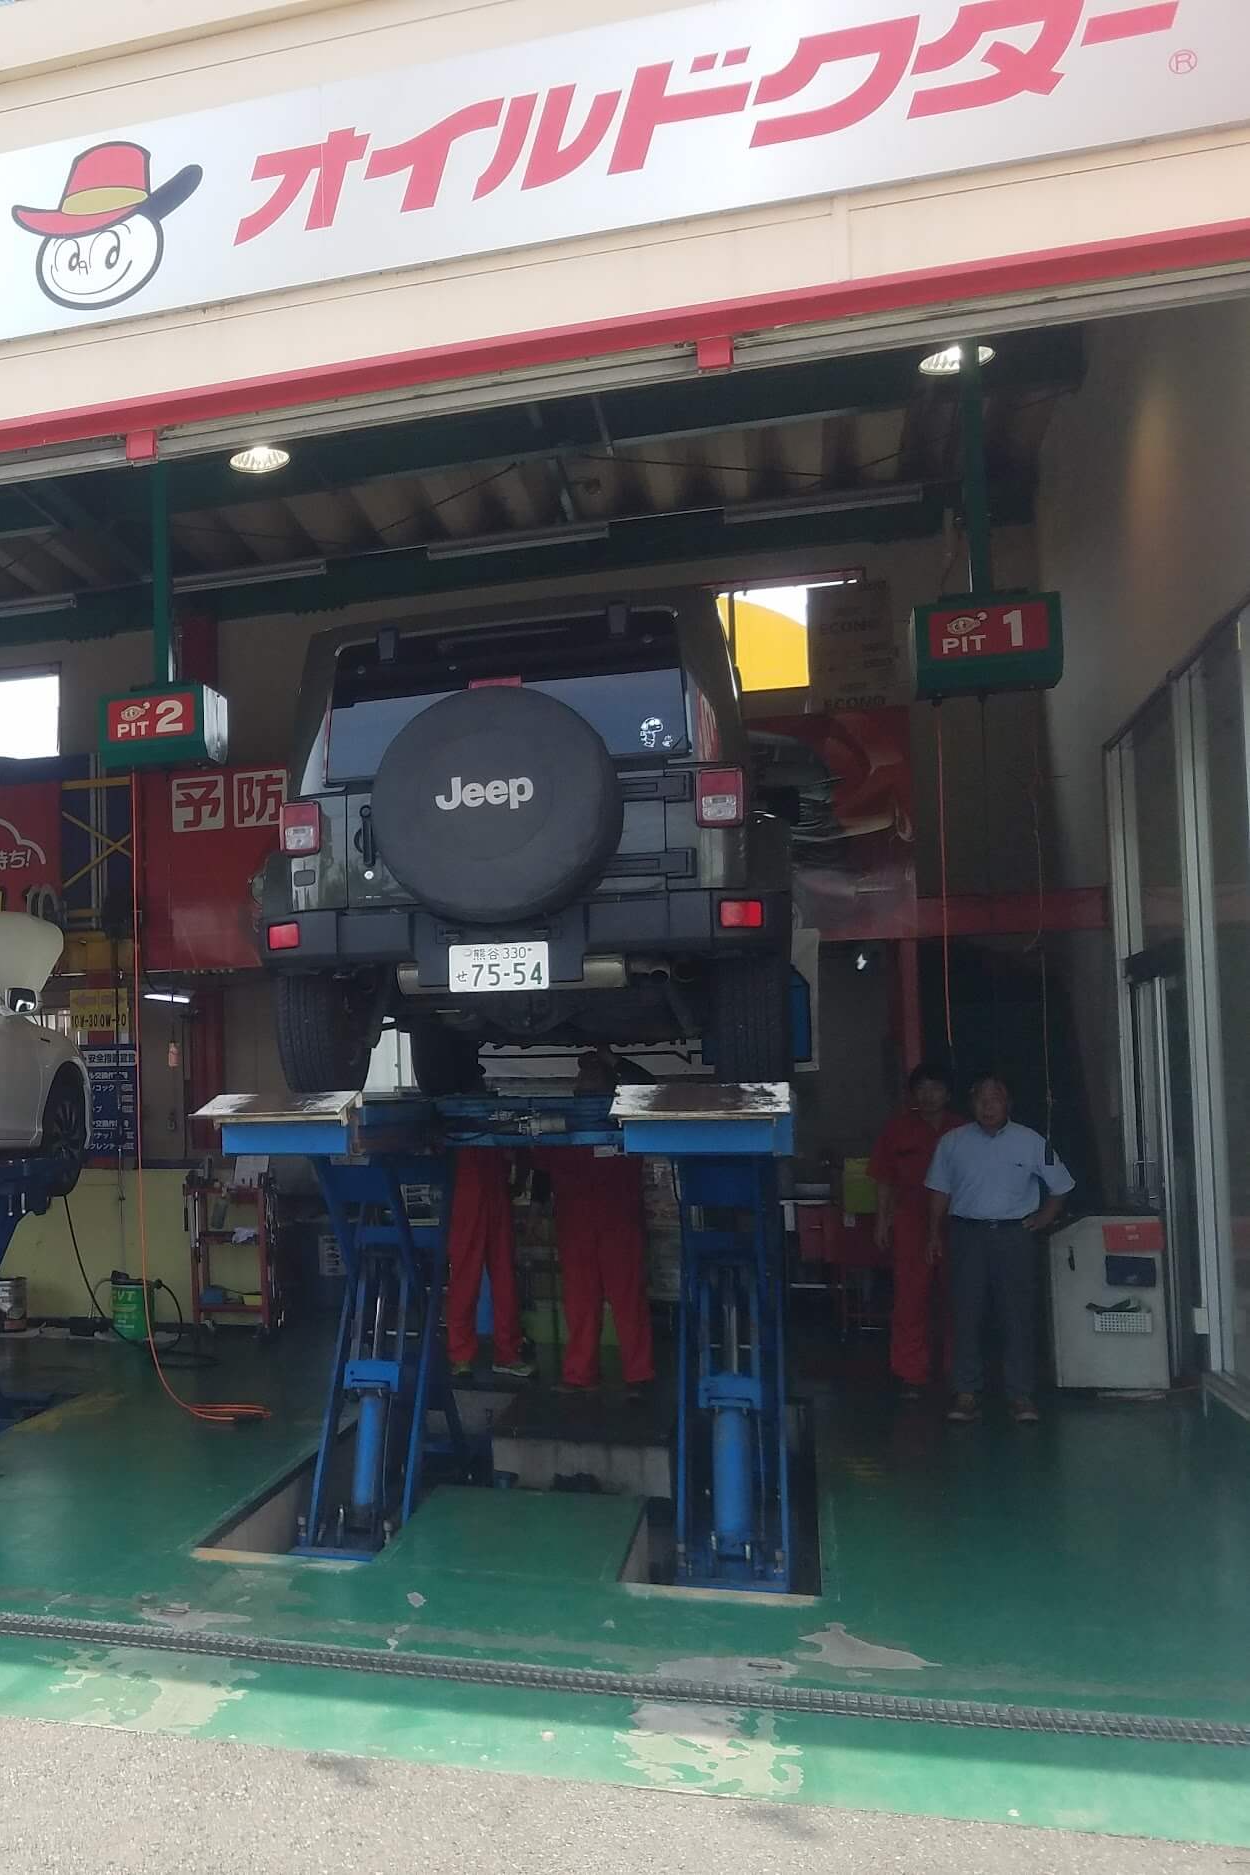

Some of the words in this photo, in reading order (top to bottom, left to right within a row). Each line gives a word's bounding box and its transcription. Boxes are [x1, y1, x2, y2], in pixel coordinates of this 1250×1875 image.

[234, 0, 1179, 246] オイルドクター
[942, 634, 987, 654] PIT
[1002, 609, 1023, 647] 1
[117, 721, 149, 738] PIT
[155, 699, 183, 733] 2
[435, 775, 534, 810] Jeep
[471, 961, 543, 988] 75-54
